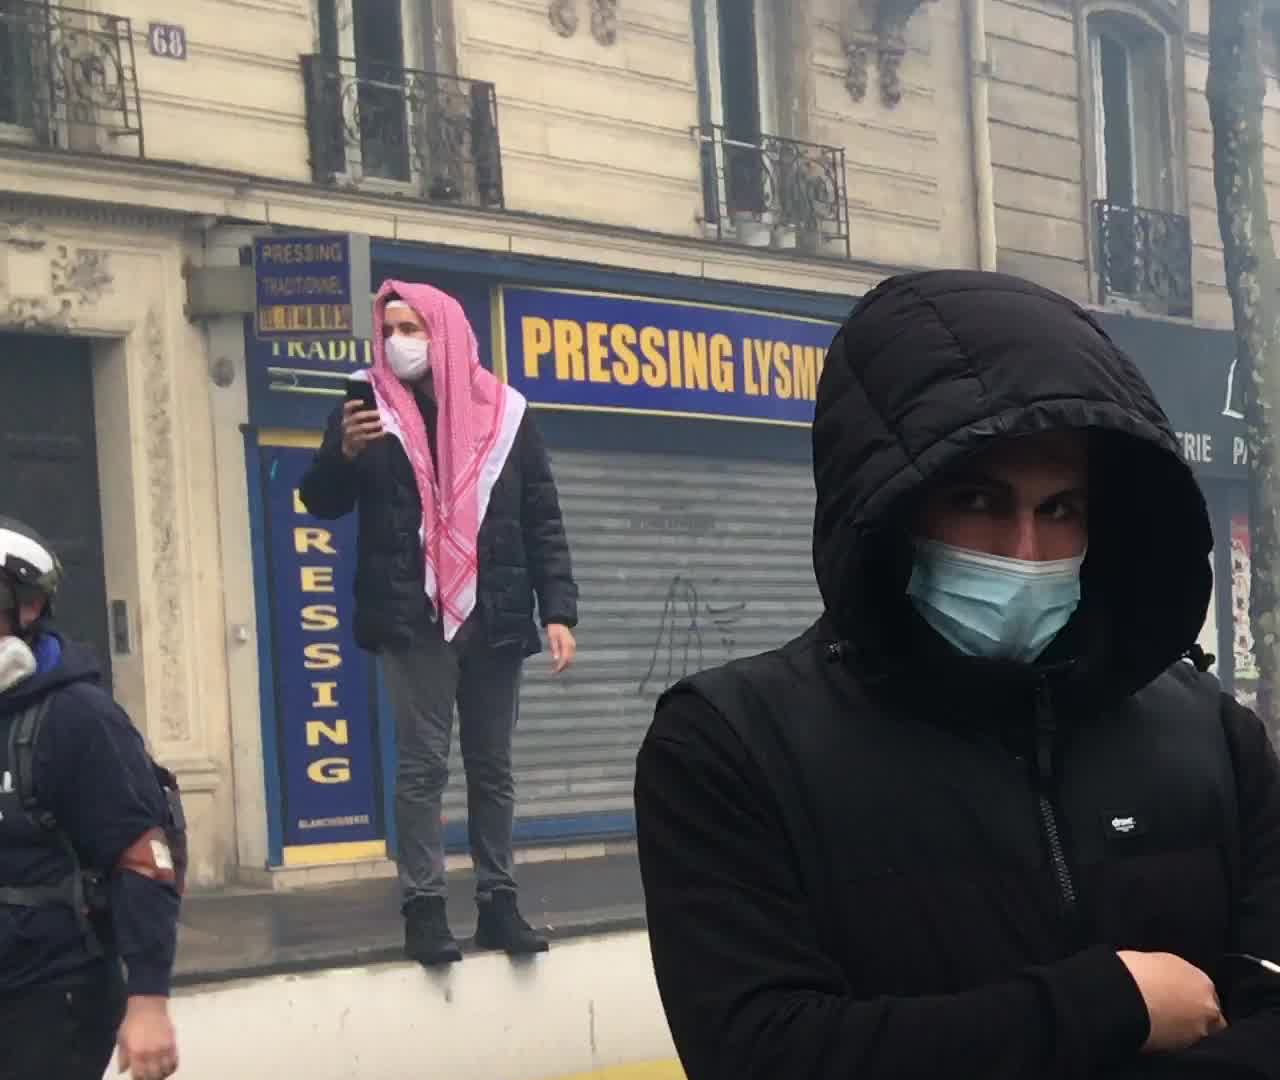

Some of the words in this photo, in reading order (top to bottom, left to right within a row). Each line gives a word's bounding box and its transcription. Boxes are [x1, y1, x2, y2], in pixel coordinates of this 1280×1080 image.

[153, 27, 182, 56] 68
[262, 243, 343, 264] PRESSING
[521, 316, 735, 393] PRESSING
